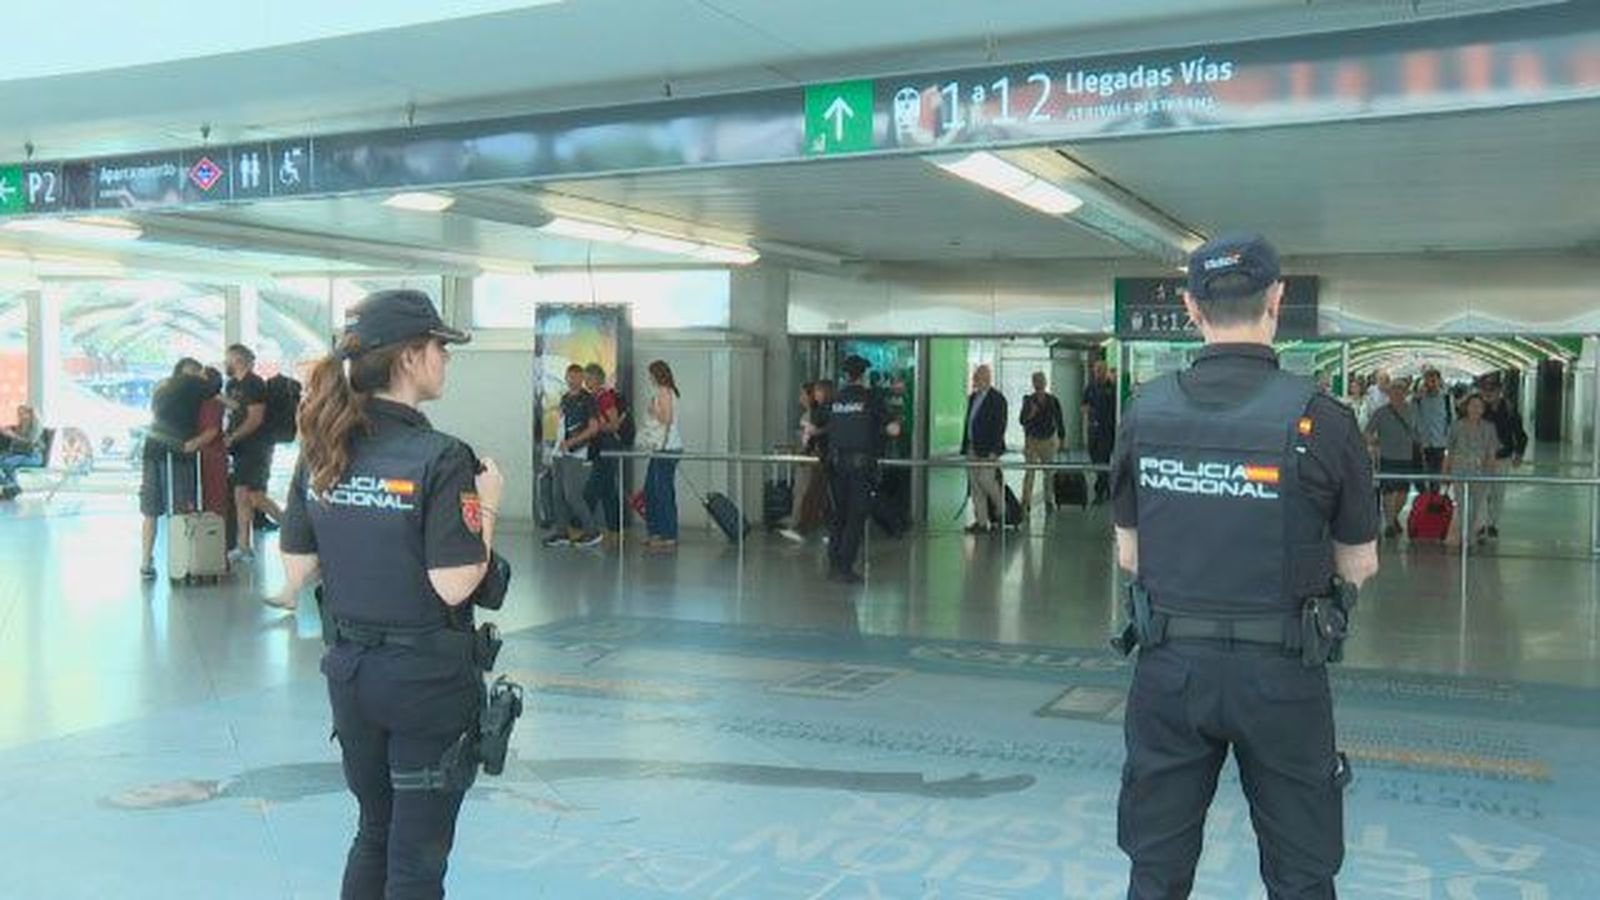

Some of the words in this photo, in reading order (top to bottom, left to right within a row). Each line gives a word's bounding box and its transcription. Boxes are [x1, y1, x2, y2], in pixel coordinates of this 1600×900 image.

[1066, 65, 1173, 96] Llegadas
[1180, 57, 1233, 85] Vías
[28, 172, 56, 203] P2
[1140, 457, 1248, 480] POLICIA
[1140, 472, 1279, 498] NACIONAL
